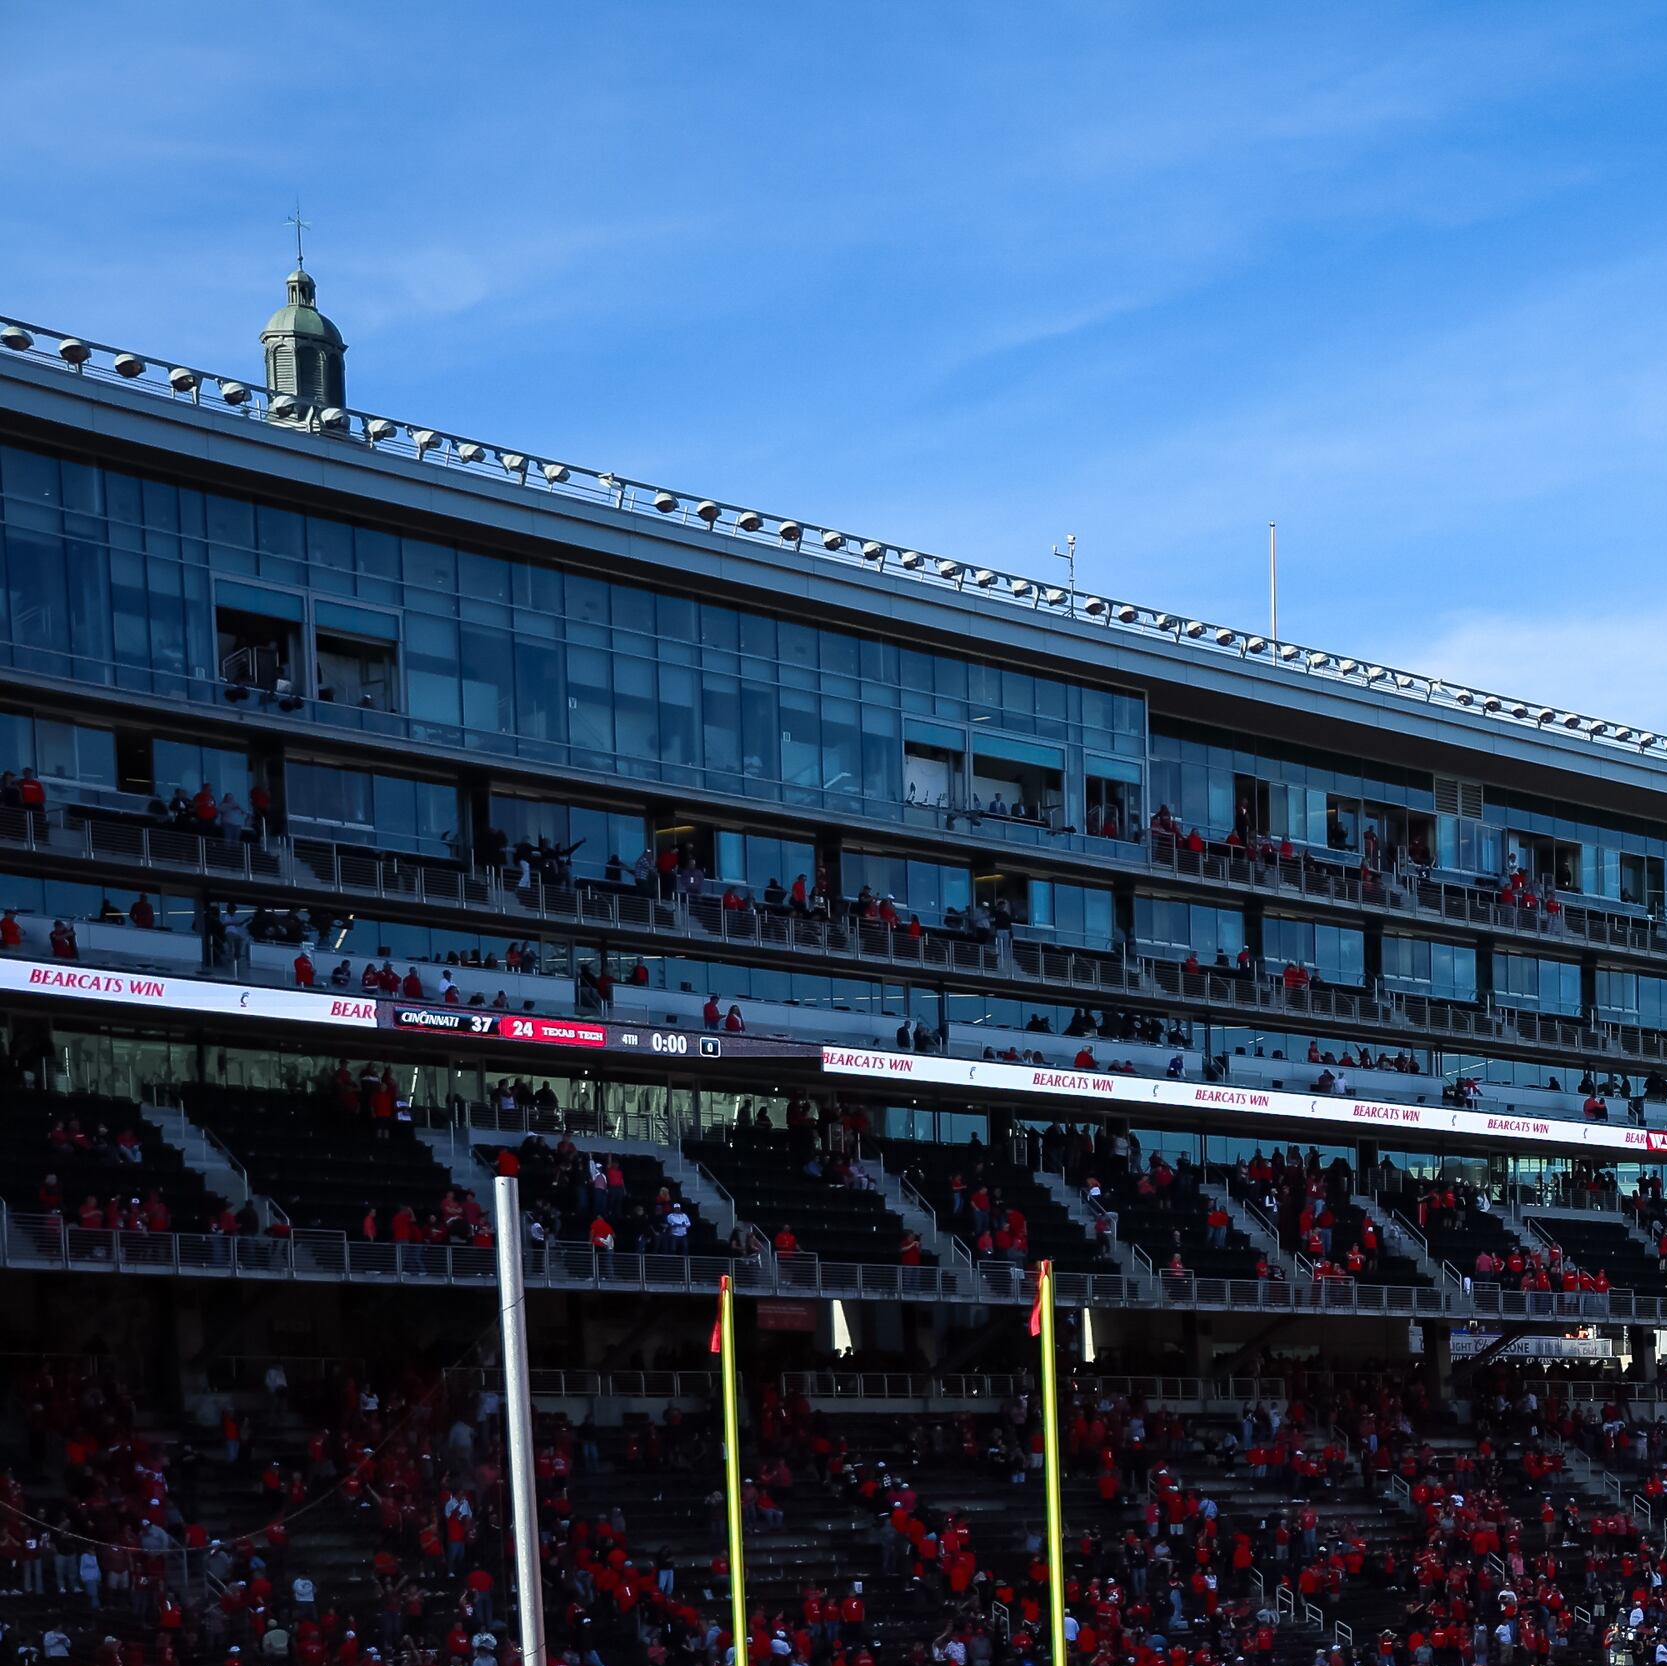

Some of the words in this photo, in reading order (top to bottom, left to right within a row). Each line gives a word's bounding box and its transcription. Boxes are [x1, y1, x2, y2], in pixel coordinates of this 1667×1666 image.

[29, 968, 123, 993] BEARCATS
[129, 979, 165, 998] WIN
[401, 1010, 460, 1028] CINCINNATI
[471, 1016, 493, 1033] 37
[512, 1021, 534, 1037] 24
[577, 1030, 604, 1042] TECH
[622, 1034, 638, 1046] 4TH
[653, 1034, 687, 1053] 0:00
[822, 1052, 885, 1070] BEARCATS
[888, 1058, 914, 1073] WIN
[1032, 1072, 1090, 1091] BEARCATS
[1092, 1078, 1114, 1093] WIN
[1195, 1088, 1248, 1105] BEARCATS
[1249, 1094, 1270, 1107] WIN
[1352, 1104, 1400, 1121] BEARCATS
[1402, 1109, 1421, 1123] WIN
[1487, 1118, 1531, 1133] BEARCATS
[1532, 1122, 1550, 1135] WIN
